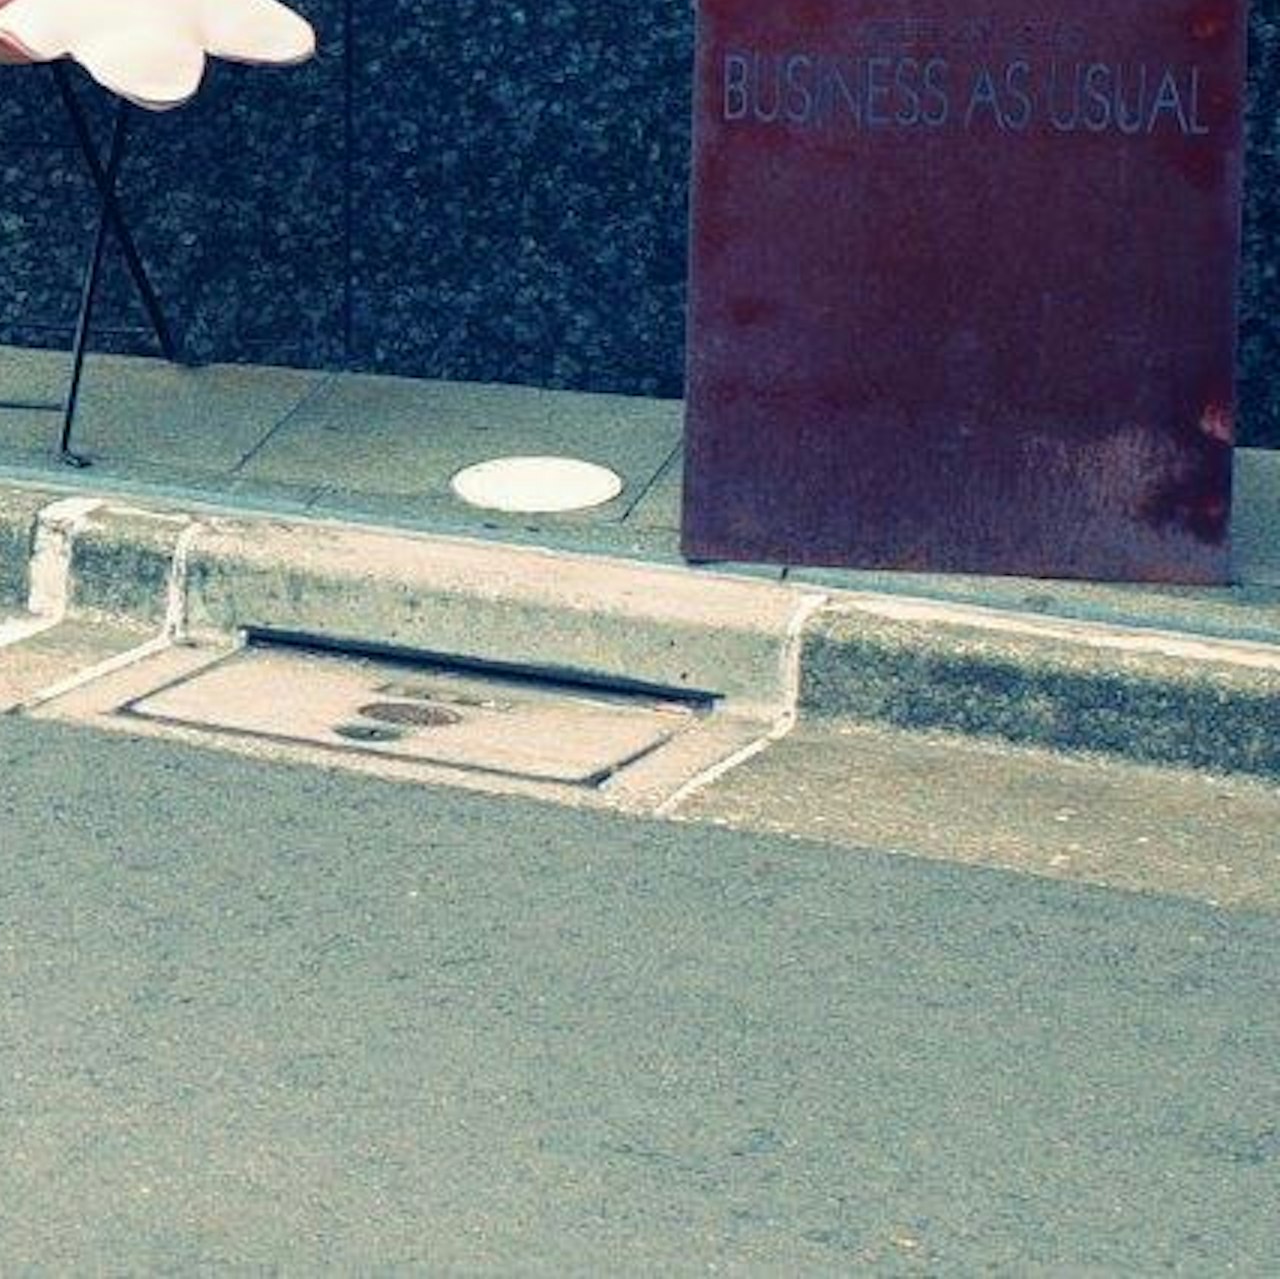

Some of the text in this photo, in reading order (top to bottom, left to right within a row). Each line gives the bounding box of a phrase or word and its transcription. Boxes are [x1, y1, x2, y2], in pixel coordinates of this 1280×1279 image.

[723, 53, 1210, 136] BUSINESS AS USUAL
